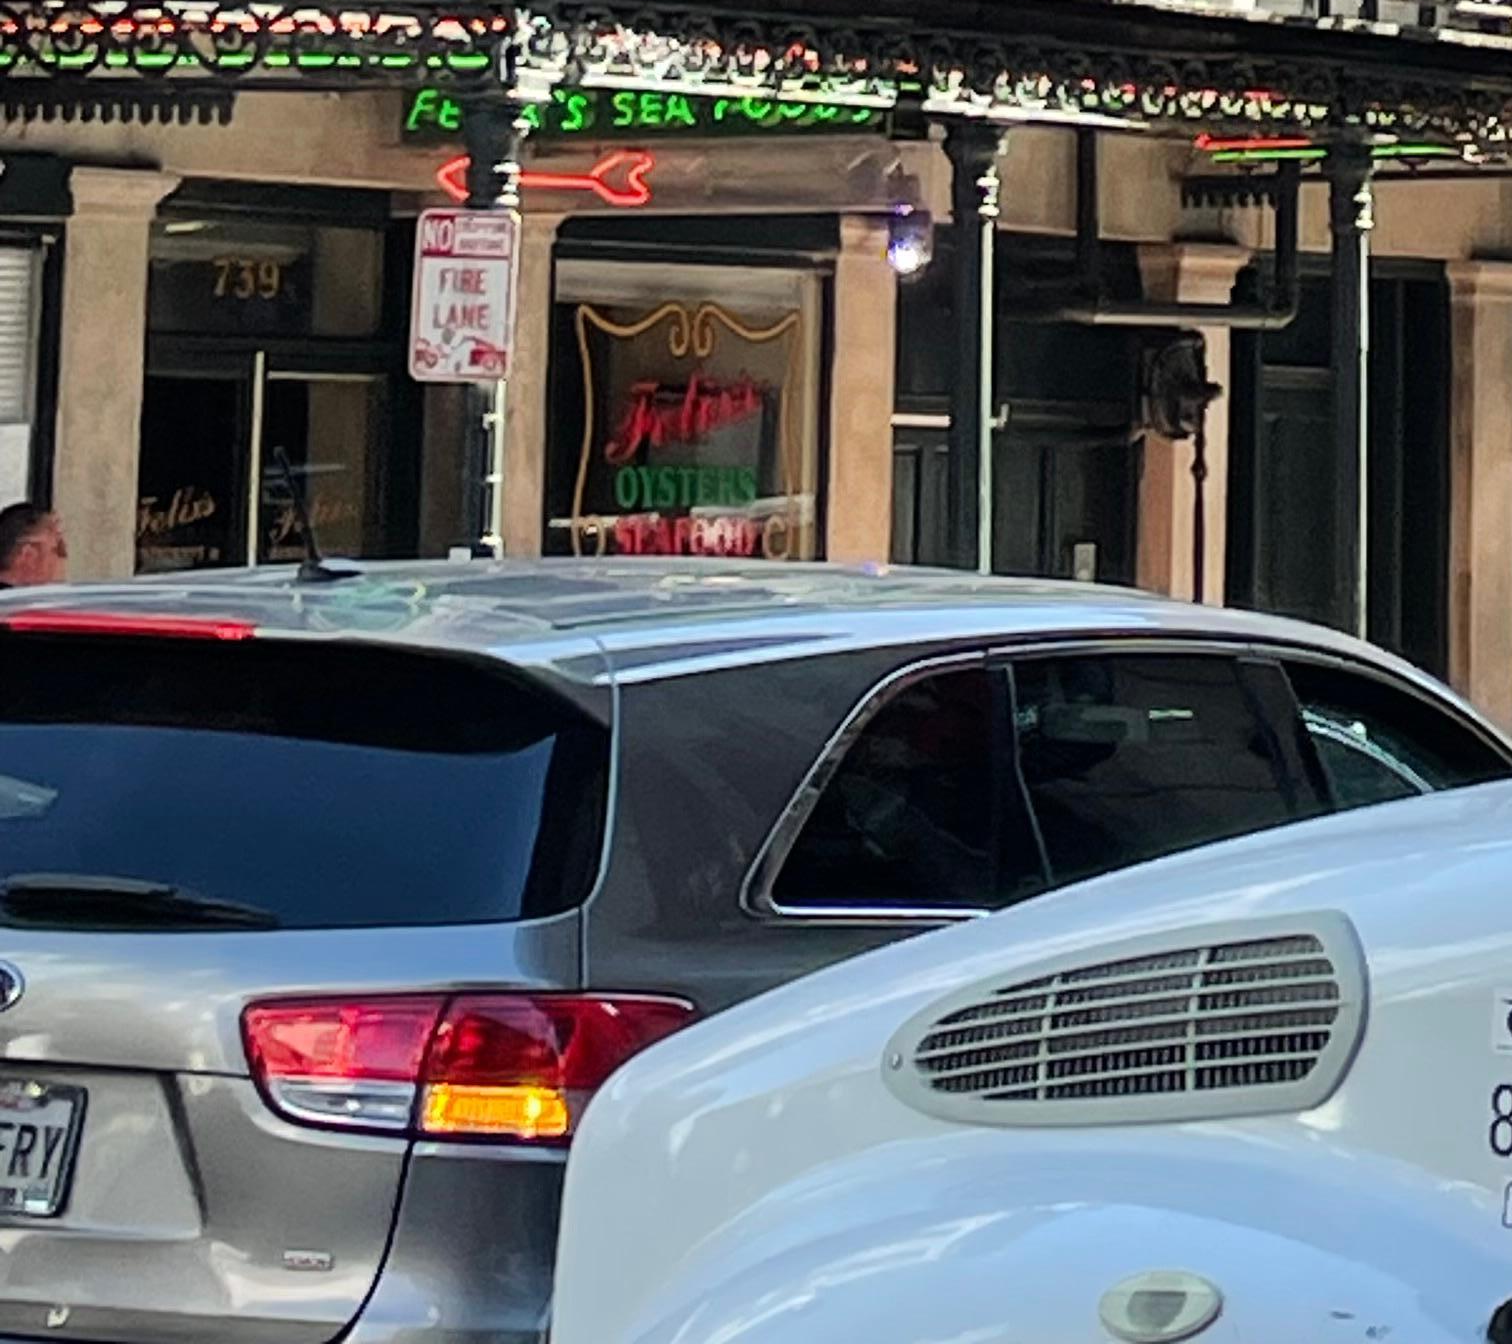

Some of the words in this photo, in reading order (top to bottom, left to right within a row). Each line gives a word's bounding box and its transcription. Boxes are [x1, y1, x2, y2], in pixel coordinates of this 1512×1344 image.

[422, 216, 455, 252] NO
[213, 257, 280, 300] 739
[438, 268, 487, 294] FIRE
[433, 302, 490, 330] LANE
[614, 465, 757, 510] OYSTERS
